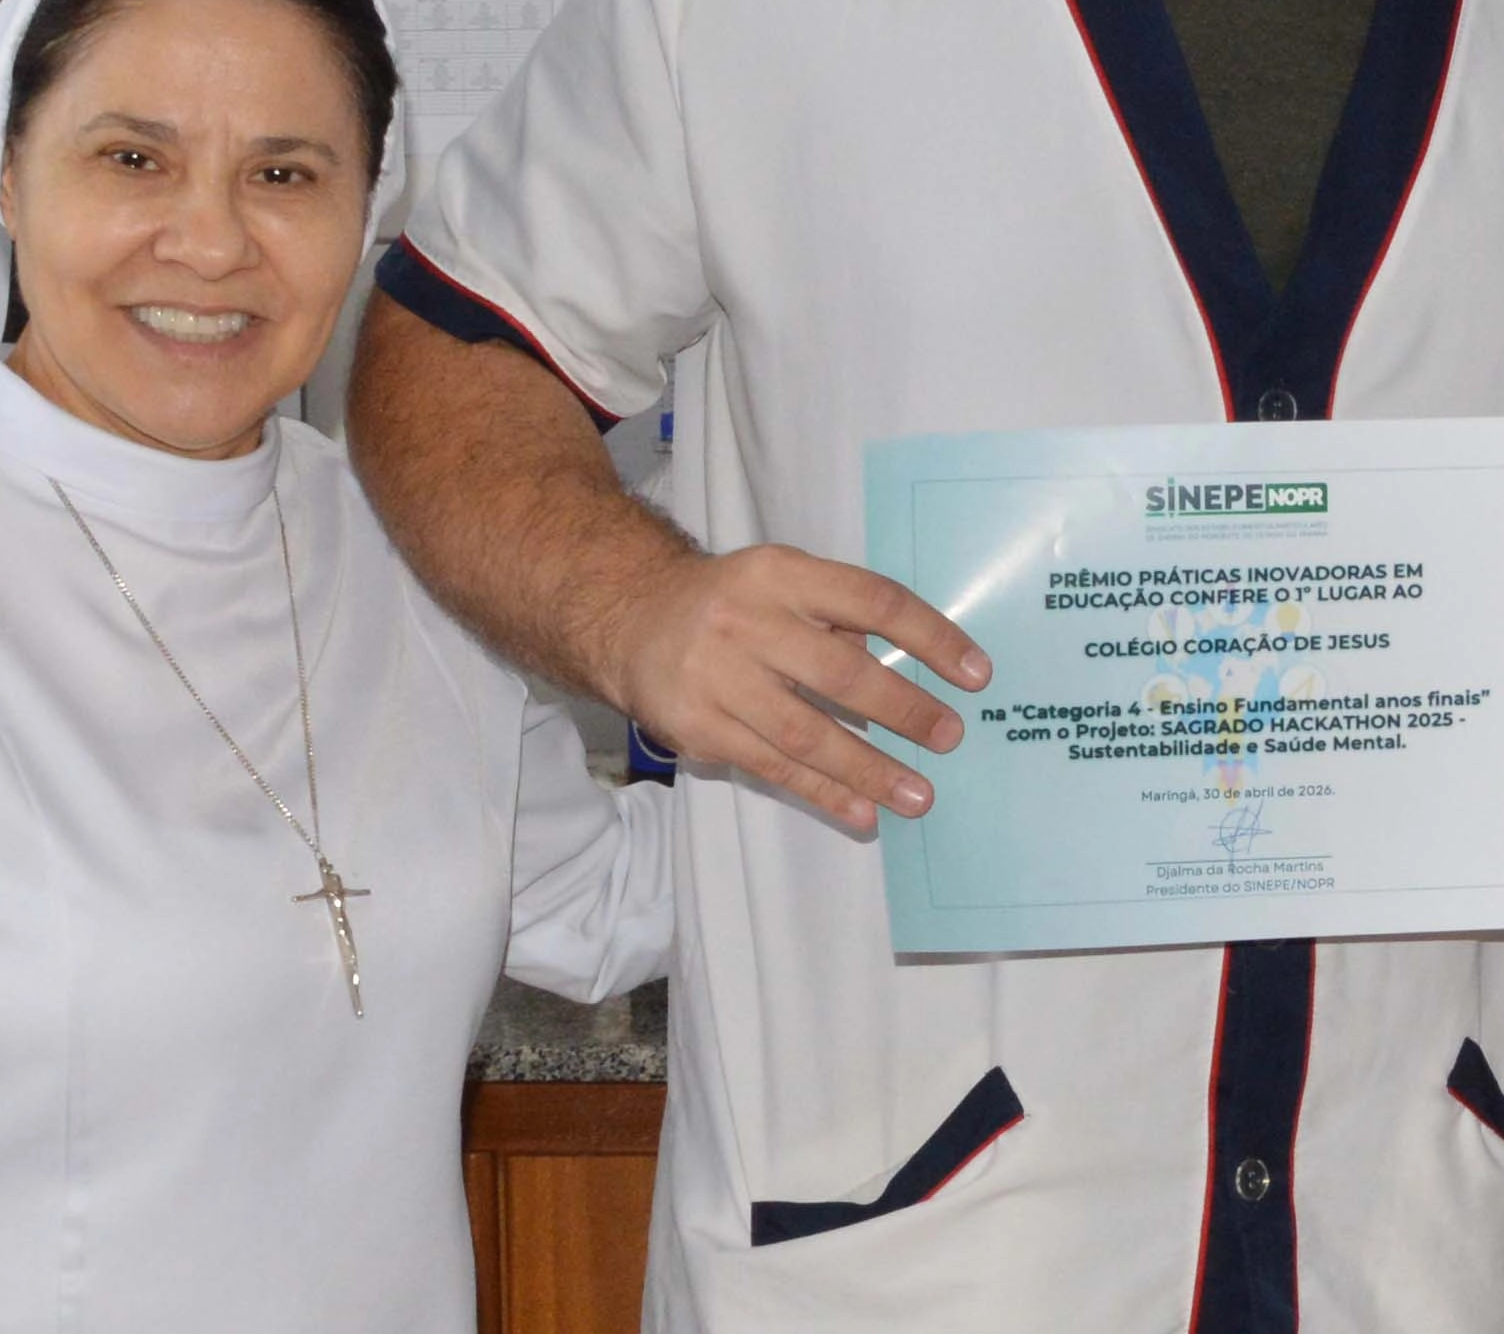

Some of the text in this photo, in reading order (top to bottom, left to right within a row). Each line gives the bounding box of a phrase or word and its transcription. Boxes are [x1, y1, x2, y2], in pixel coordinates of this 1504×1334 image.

[1268, 487, 1324, 507] NOPR
[1049, 563, 1424, 588] PRÊMIO PRÁTICAS INOVADORAS EM
[1045, 588, 1165, 612] EDUCAÇÃO
[1170, 587, 1268, 605] CONFERE
[1274, 587, 1291, 603] O
[1317, 584, 1386, 602] LUGAR
[1392, 583, 1424, 600] AO
[1084, 633, 1390, 659] COLÉGIO CORAÇÃO DE JESUS
[981, 708, 1007, 722] na
[1128, 701, 1142, 717] 4
[1160, 697, 1229, 716] Ensino
[1234, 692, 1370, 714] Fundamental
[1375, 693, 1423, 709] anos
[1006, 727, 1051, 742] com
[1057, 727, 1070, 741] o
[1075, 721, 1156, 743] Projeto:
[1161, 717, 1264, 737] SAGRADO
[1270, 713, 1401, 734] HACKATHON
[1407, 712, 1454, 730] 2025
[1068, 733, 1407, 761] Sustentabilidade e Saúde Mental.
[1141, 784, 1336, 804] Maringá, 30 de abril de 2026.
[1156, 860, 1324, 880] Djalma da Rocha Martins
[1146, 877, 1335, 897] Presidente do SINEPE/NOPR
